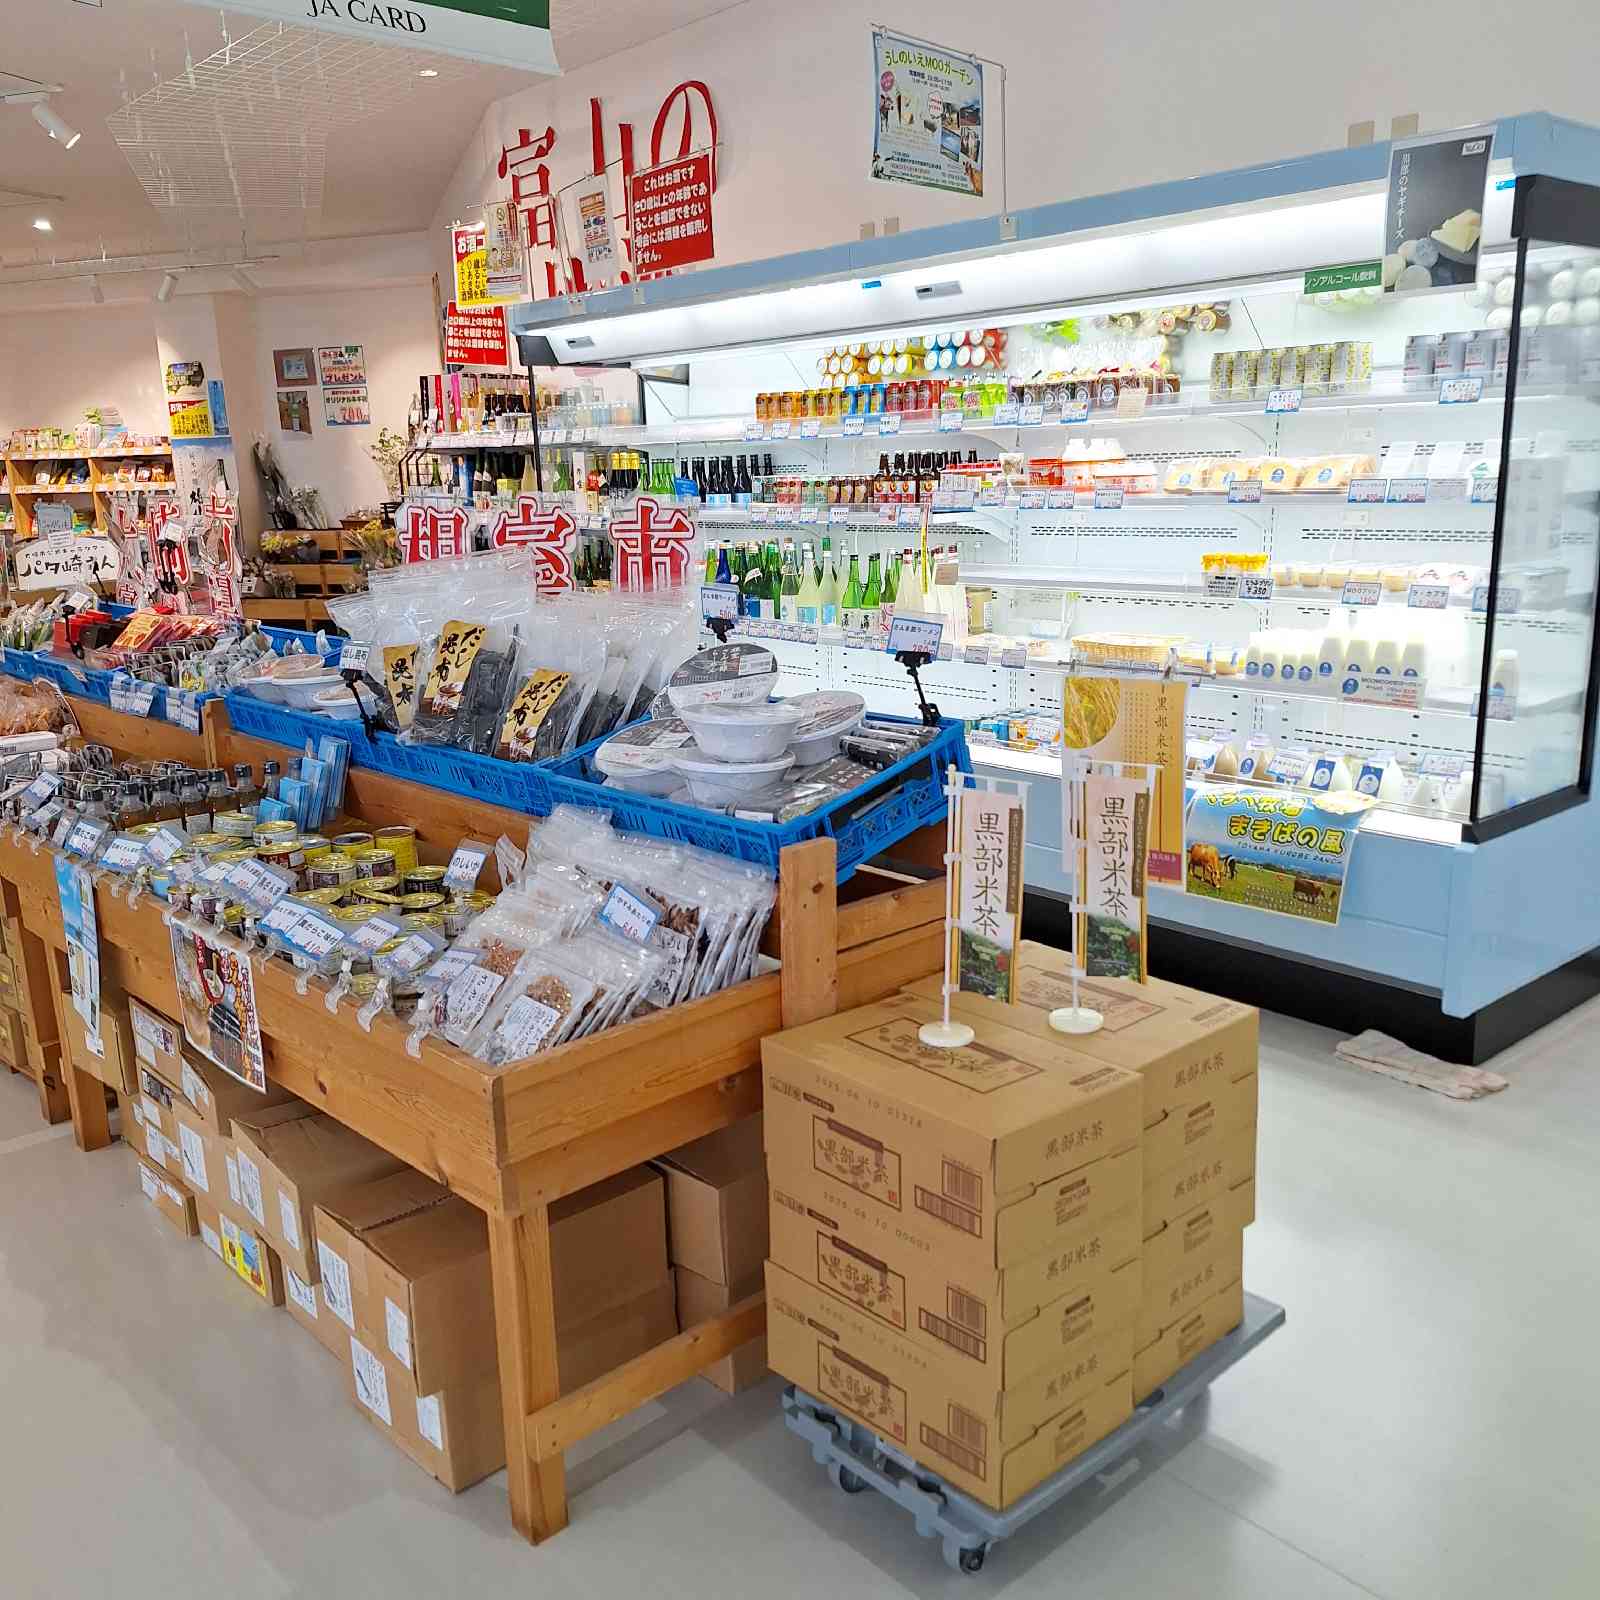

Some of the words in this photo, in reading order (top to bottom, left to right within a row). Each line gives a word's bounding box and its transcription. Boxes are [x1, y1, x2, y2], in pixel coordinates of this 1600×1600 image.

[306, 0, 341, 17] JA
[348, 0, 427, 33] CARD
[1154, 697, 1169, 768] 黒部米茶
[1098, 796, 1130, 919] 黒部米茶
[1229, 814, 1344, 856] まきばの風
[972, 812, 1004, 937] 黒部米茶
[1174, 1051, 1225, 1089] 黒部米茶
[822, 1137, 890, 1185] 黒部米茶
[1046, 1120, 1104, 1161] 黒部米茶
[1174, 1160, 1224, 1200] 黒部米茶
[1046, 1236, 1102, 1281] 黒部米茶
[1045, 1353, 1100, 1401] 黒部米茶
